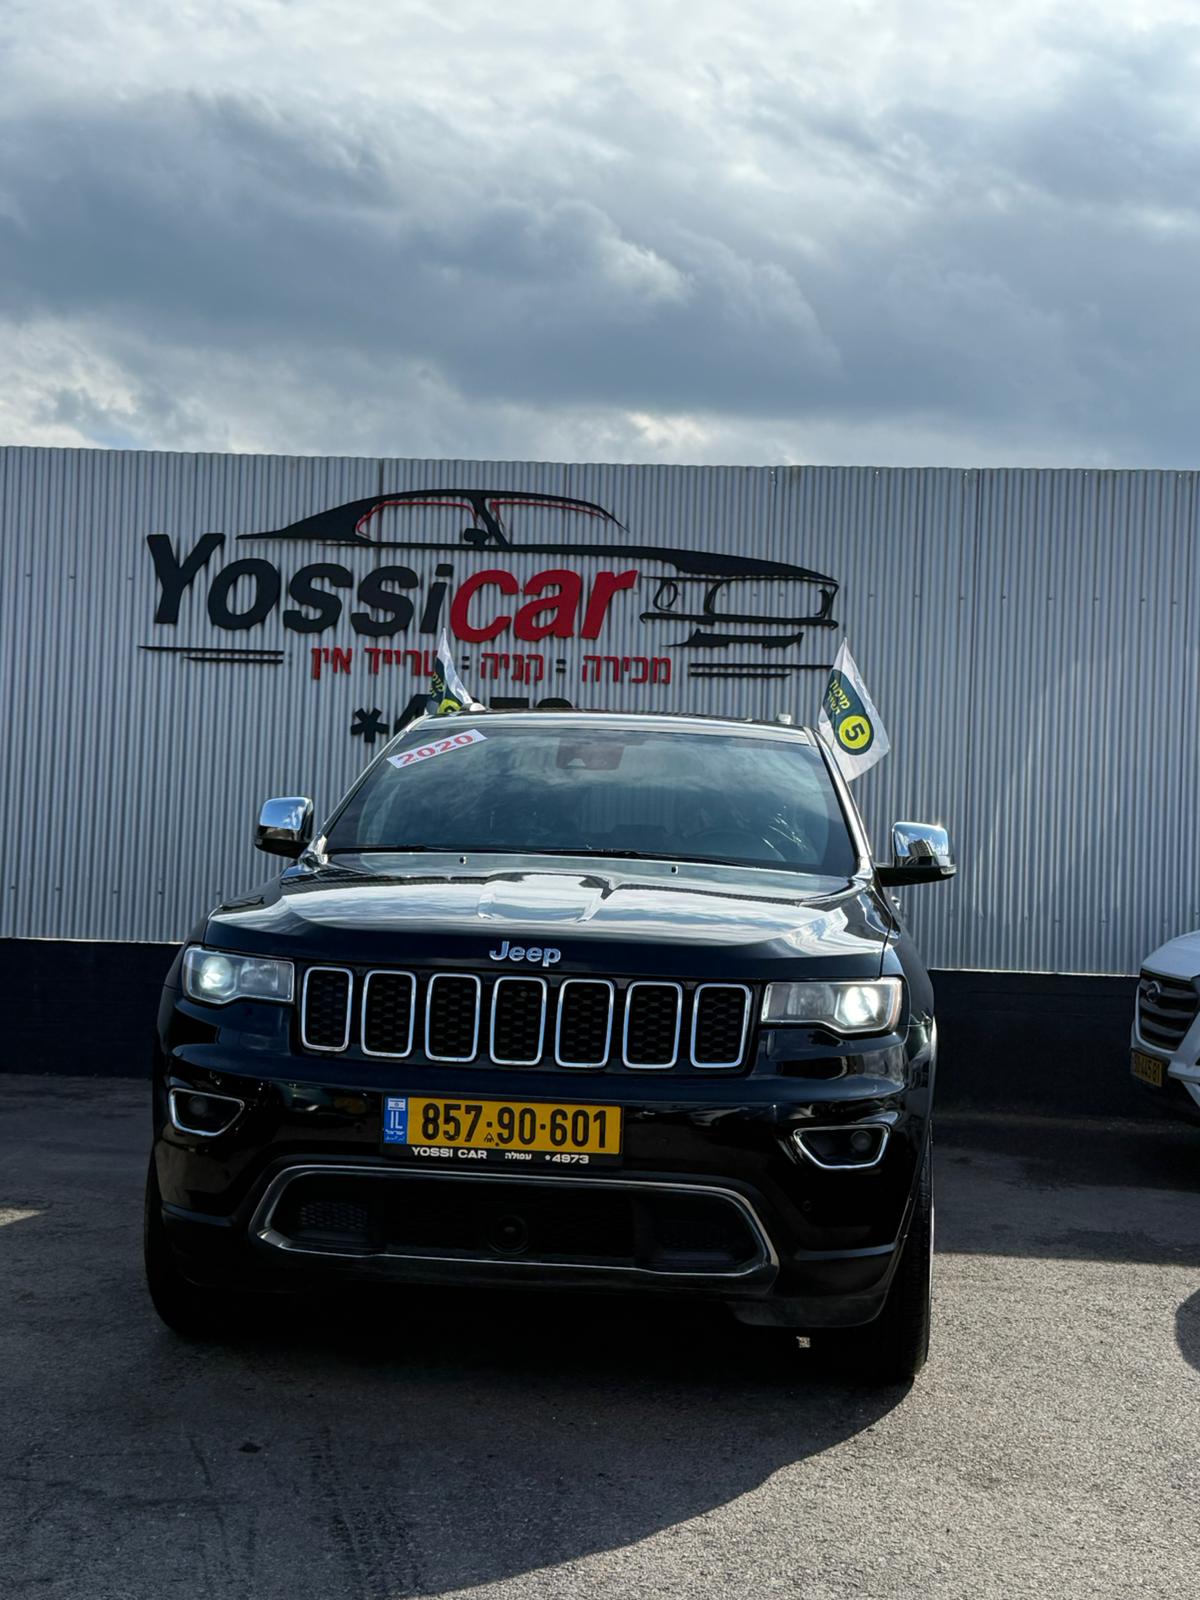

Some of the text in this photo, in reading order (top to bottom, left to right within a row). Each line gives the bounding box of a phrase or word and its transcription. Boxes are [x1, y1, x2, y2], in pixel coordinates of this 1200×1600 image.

[311, 648, 353, 681] אין
[481, 653, 544, 685] קניה
[582, 655, 672, 685] מכירה
[844, 722, 866, 742] 5
[397, 733, 474, 765] 2020
[489, 940, 562, 968] Jeep
[390, 1111, 404, 1130] IL
[412, 1146, 454, 1159] YOSSI
[457, 1149, 488, 1160] CAR
[504, 1151, 533, 1161] עפולה
